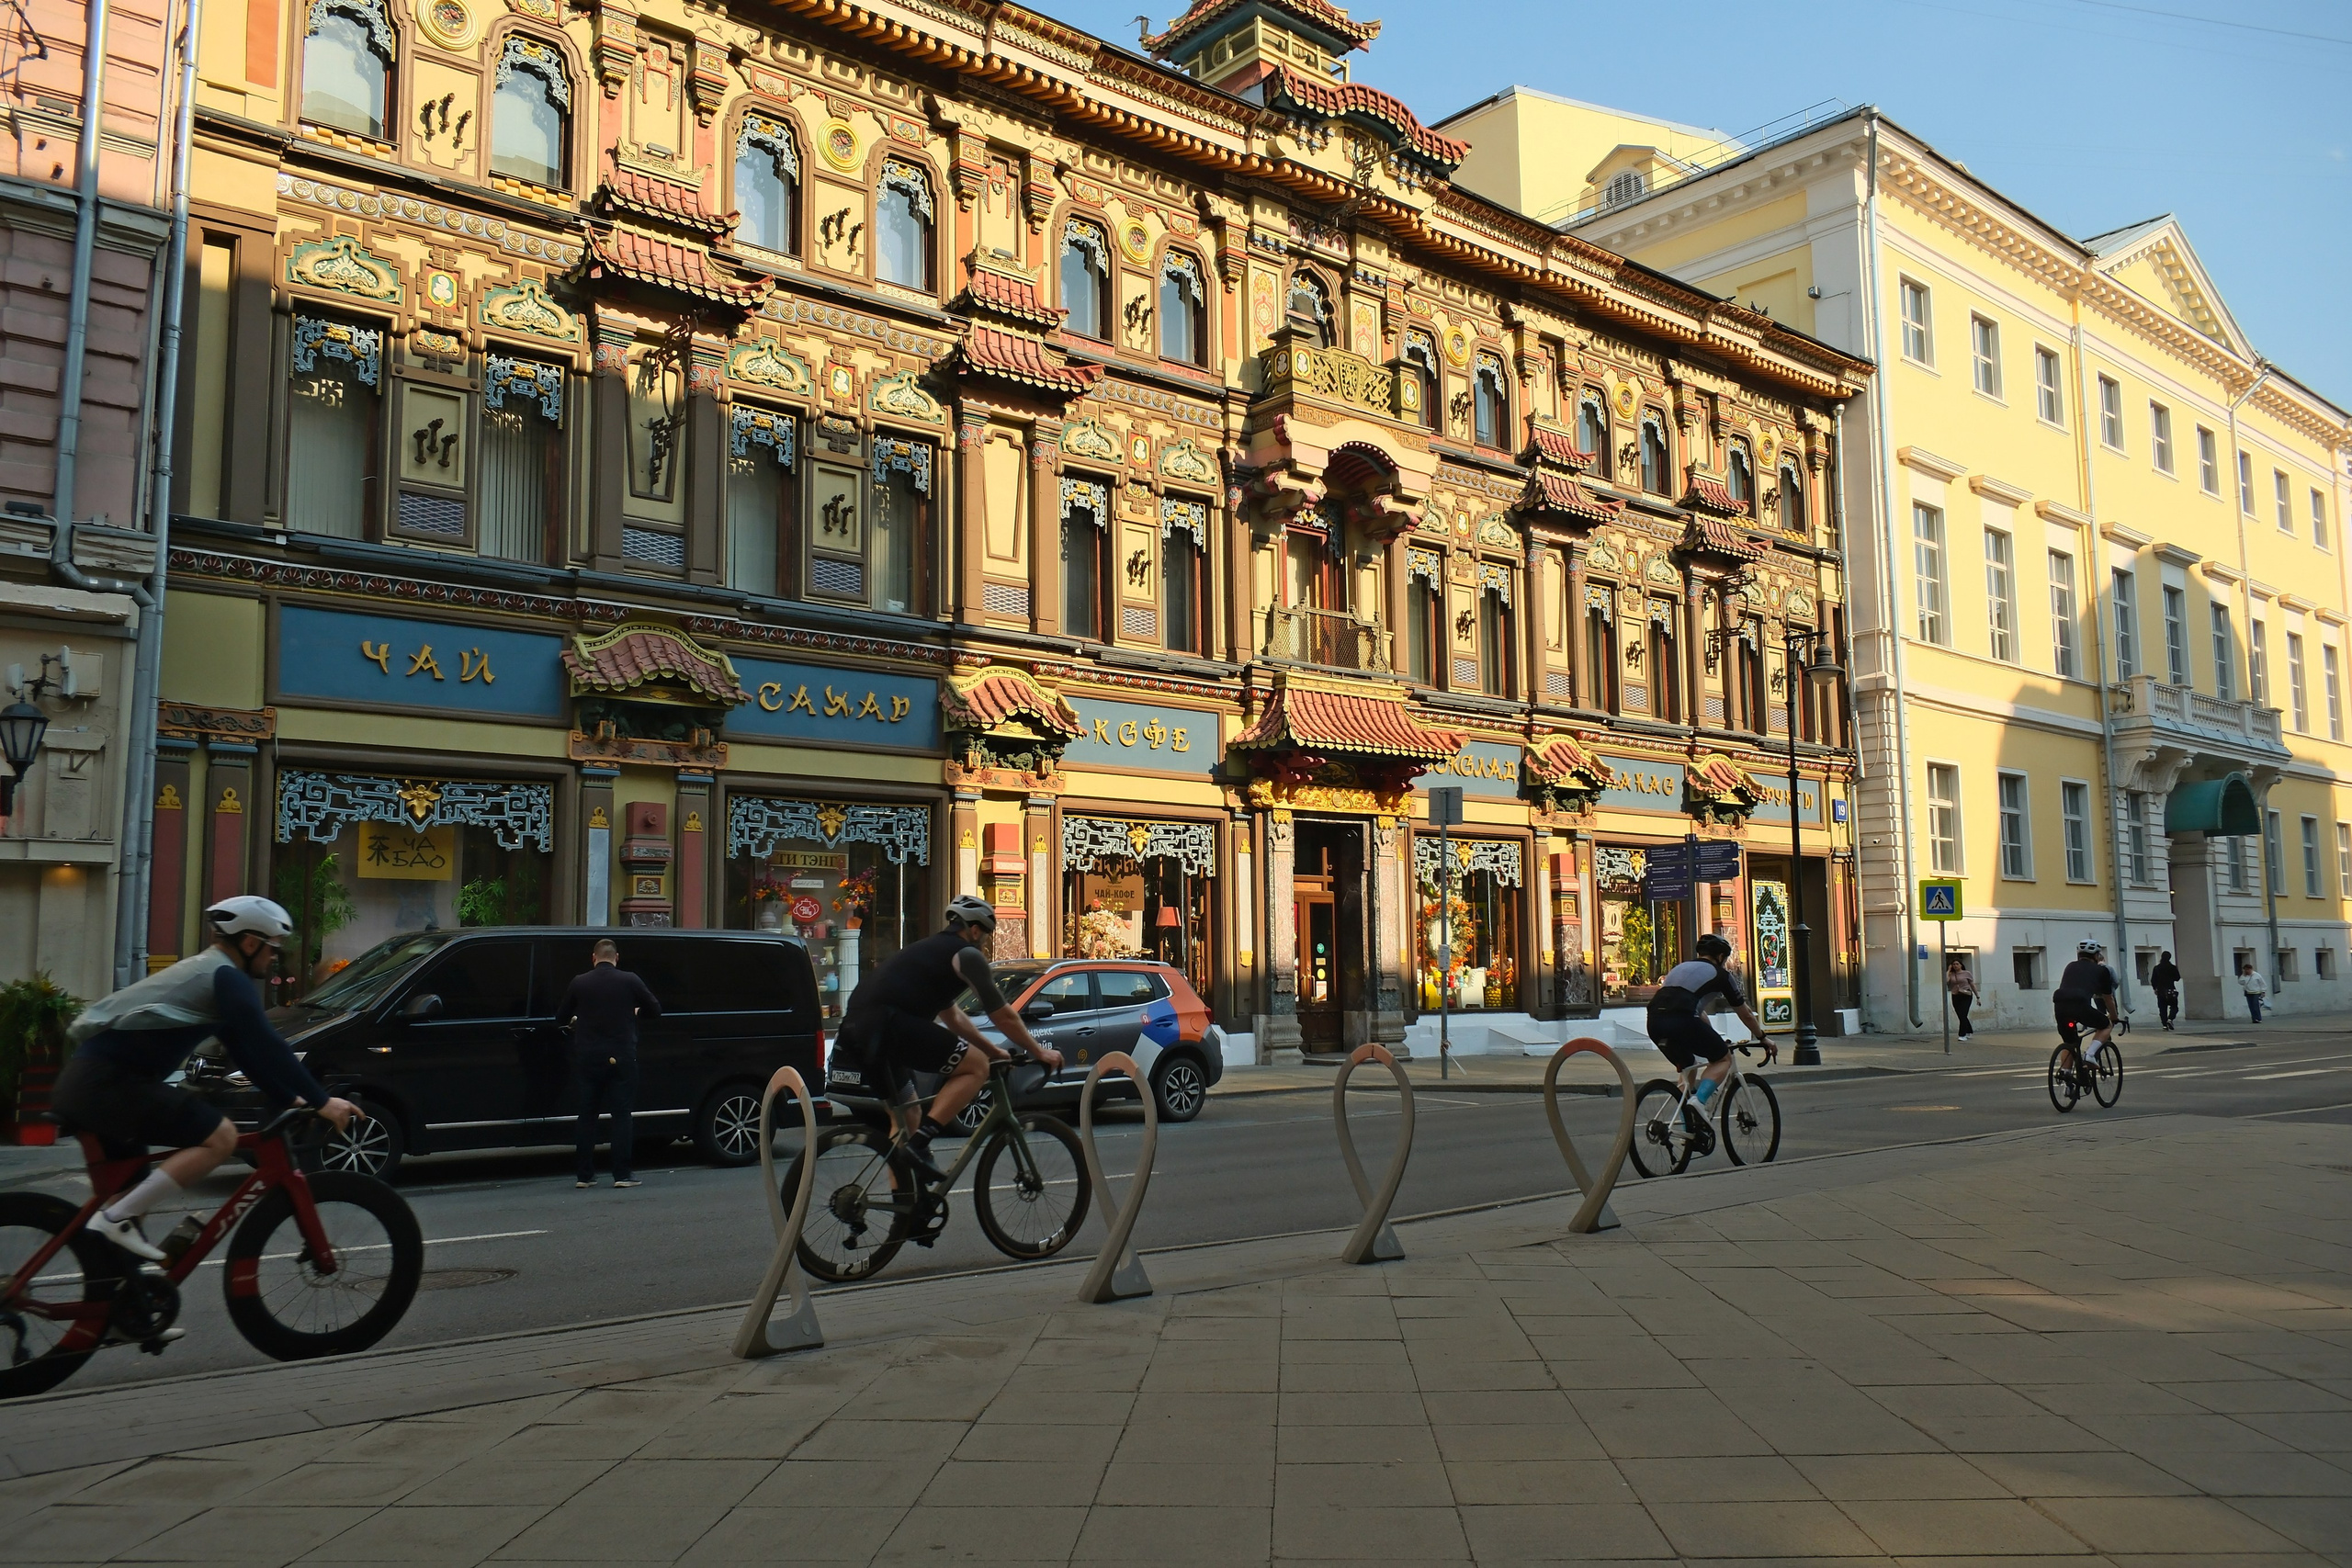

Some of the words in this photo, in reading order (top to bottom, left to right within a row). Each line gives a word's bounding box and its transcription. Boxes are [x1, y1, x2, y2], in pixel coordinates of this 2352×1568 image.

[361, 640, 496, 684] ЧАЙ
[758, 682, 910, 723] САХАР
[1093, 717, 1191, 752] КОФЕ
[1617, 771, 1675, 796] АКАО
[1838, 805, 1846, 816] 19
[392, 851, 446, 868] БАО
[777, 853, 797, 865] ТИ
[800, 854, 837, 867] ТЭНГ
[1094, 888, 1135, 898] ЧАЙ-КОФЕ
[1027, 1027, 1054, 1038] ндекс
